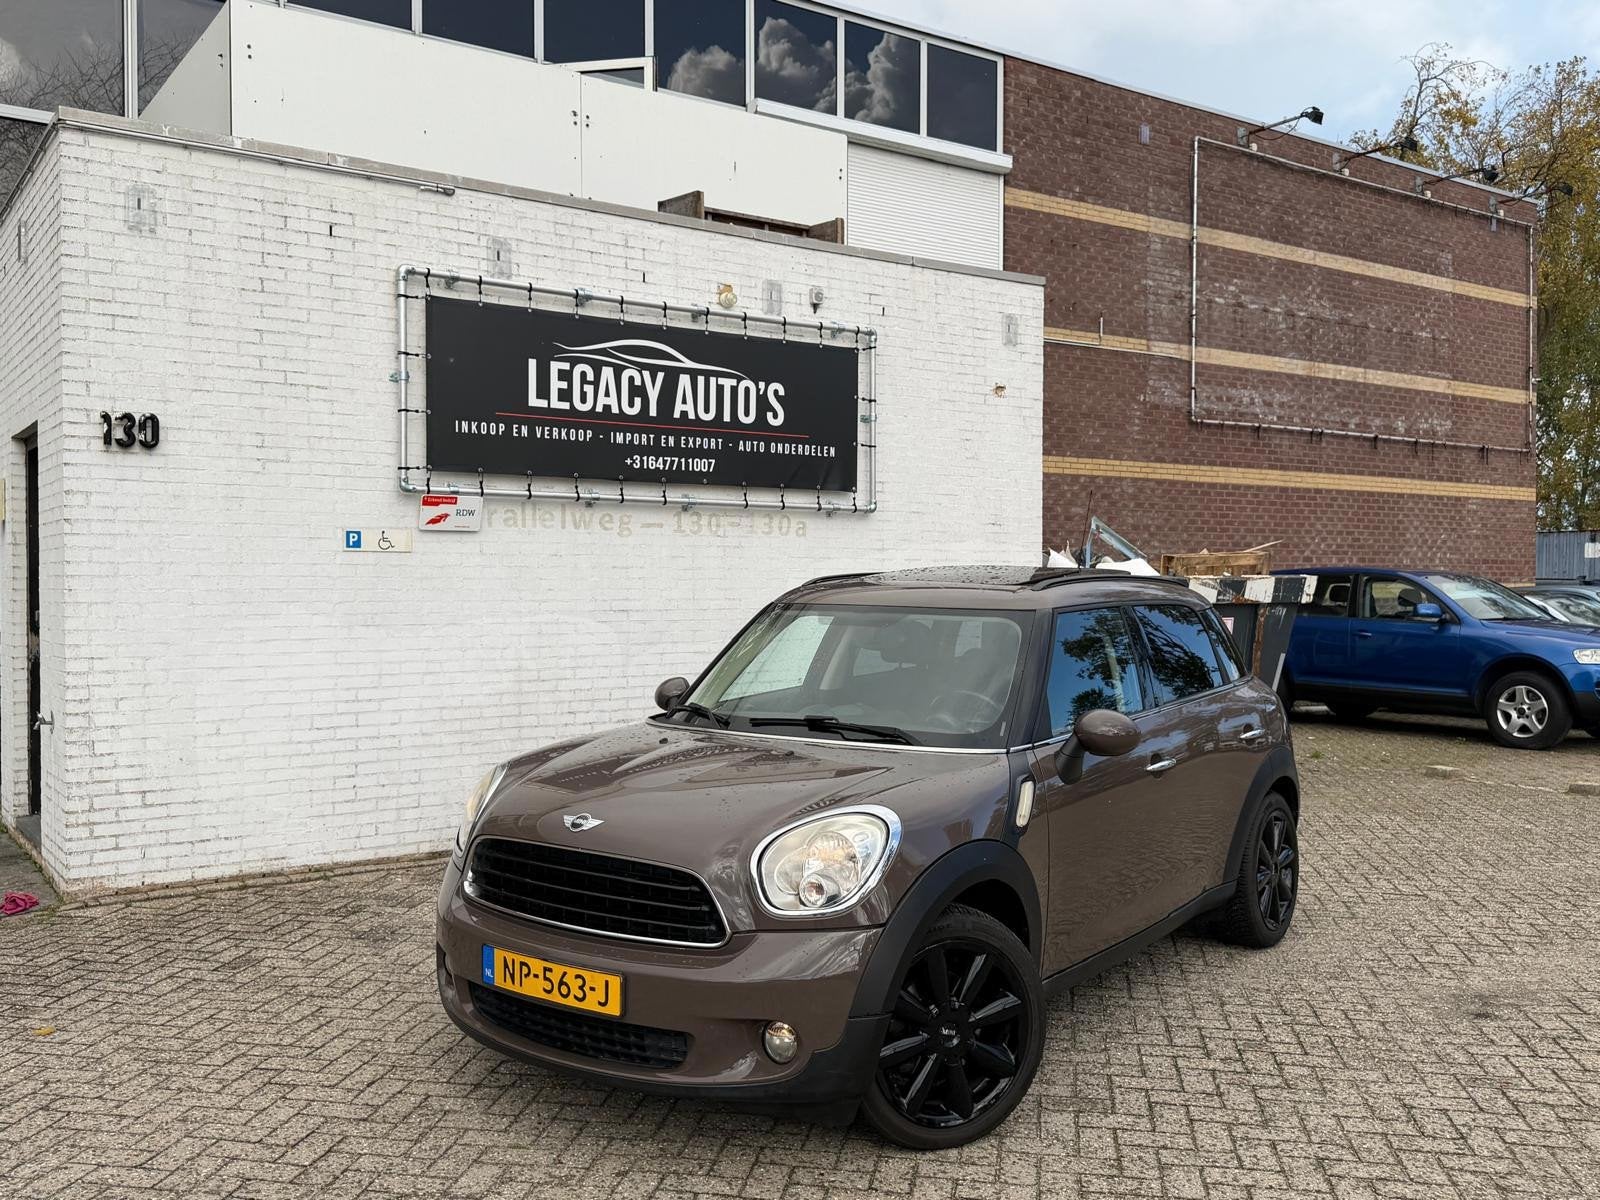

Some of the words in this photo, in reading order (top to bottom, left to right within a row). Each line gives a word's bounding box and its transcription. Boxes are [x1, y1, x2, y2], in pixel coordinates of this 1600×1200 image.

[528, 358, 665, 417] LEGACY
[673, 373, 785, 427] AUTO'S
[100, 411, 160, 449] 130
[455, 420, 506, 436] INKOOP
[512, 424, 529, 438] EN
[535, 426, 593, 442] VERKOOP
[610, 431, 655, 446] IMPORT
[661, 435, 675, 448] EN
[680, 436, 723, 450] EXPORT
[738, 440, 765, 453] AUTO
[770, 443, 836, 458] ONDERDELEN
[625, 454, 716, 472] +31647711007
[455, 508, 476, 517] RDW
[486, 502, 633, 538] rallelweg
[349, 532, 359, 546] P
[485, 968, 494, 978] NL
[503, 955, 610, 1008] NP-563-J
